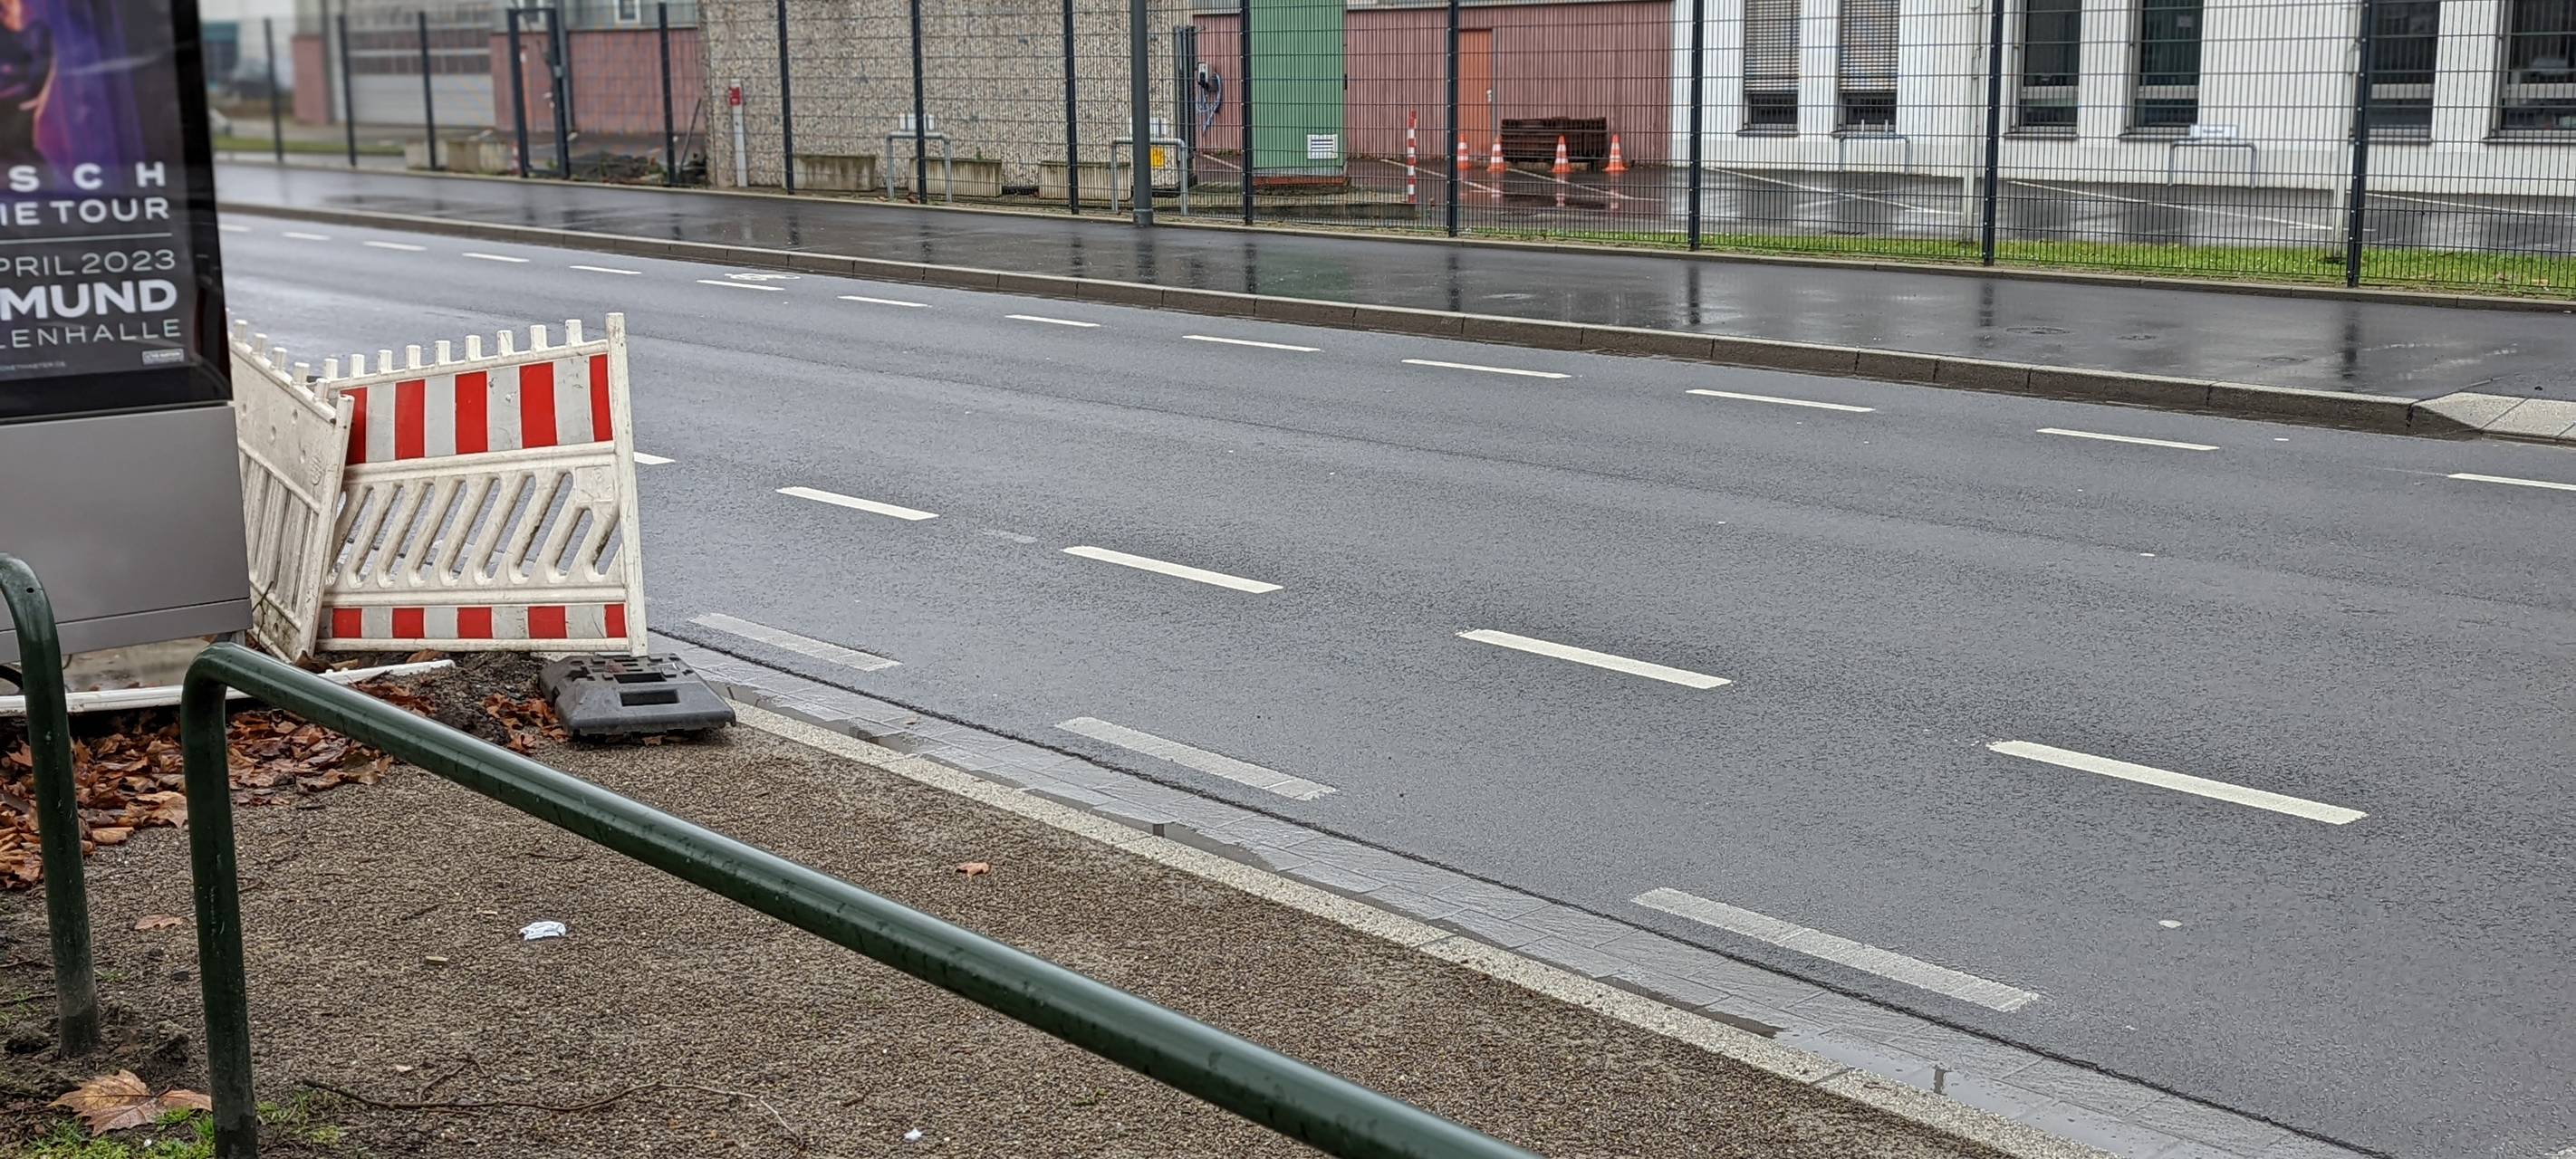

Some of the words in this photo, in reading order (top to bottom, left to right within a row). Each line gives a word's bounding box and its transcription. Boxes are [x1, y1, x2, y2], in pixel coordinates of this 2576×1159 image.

[49, 196, 169, 225] TOUR
[82, 249, 176, 274] 2023
[0, 279, 178, 321] MUND
